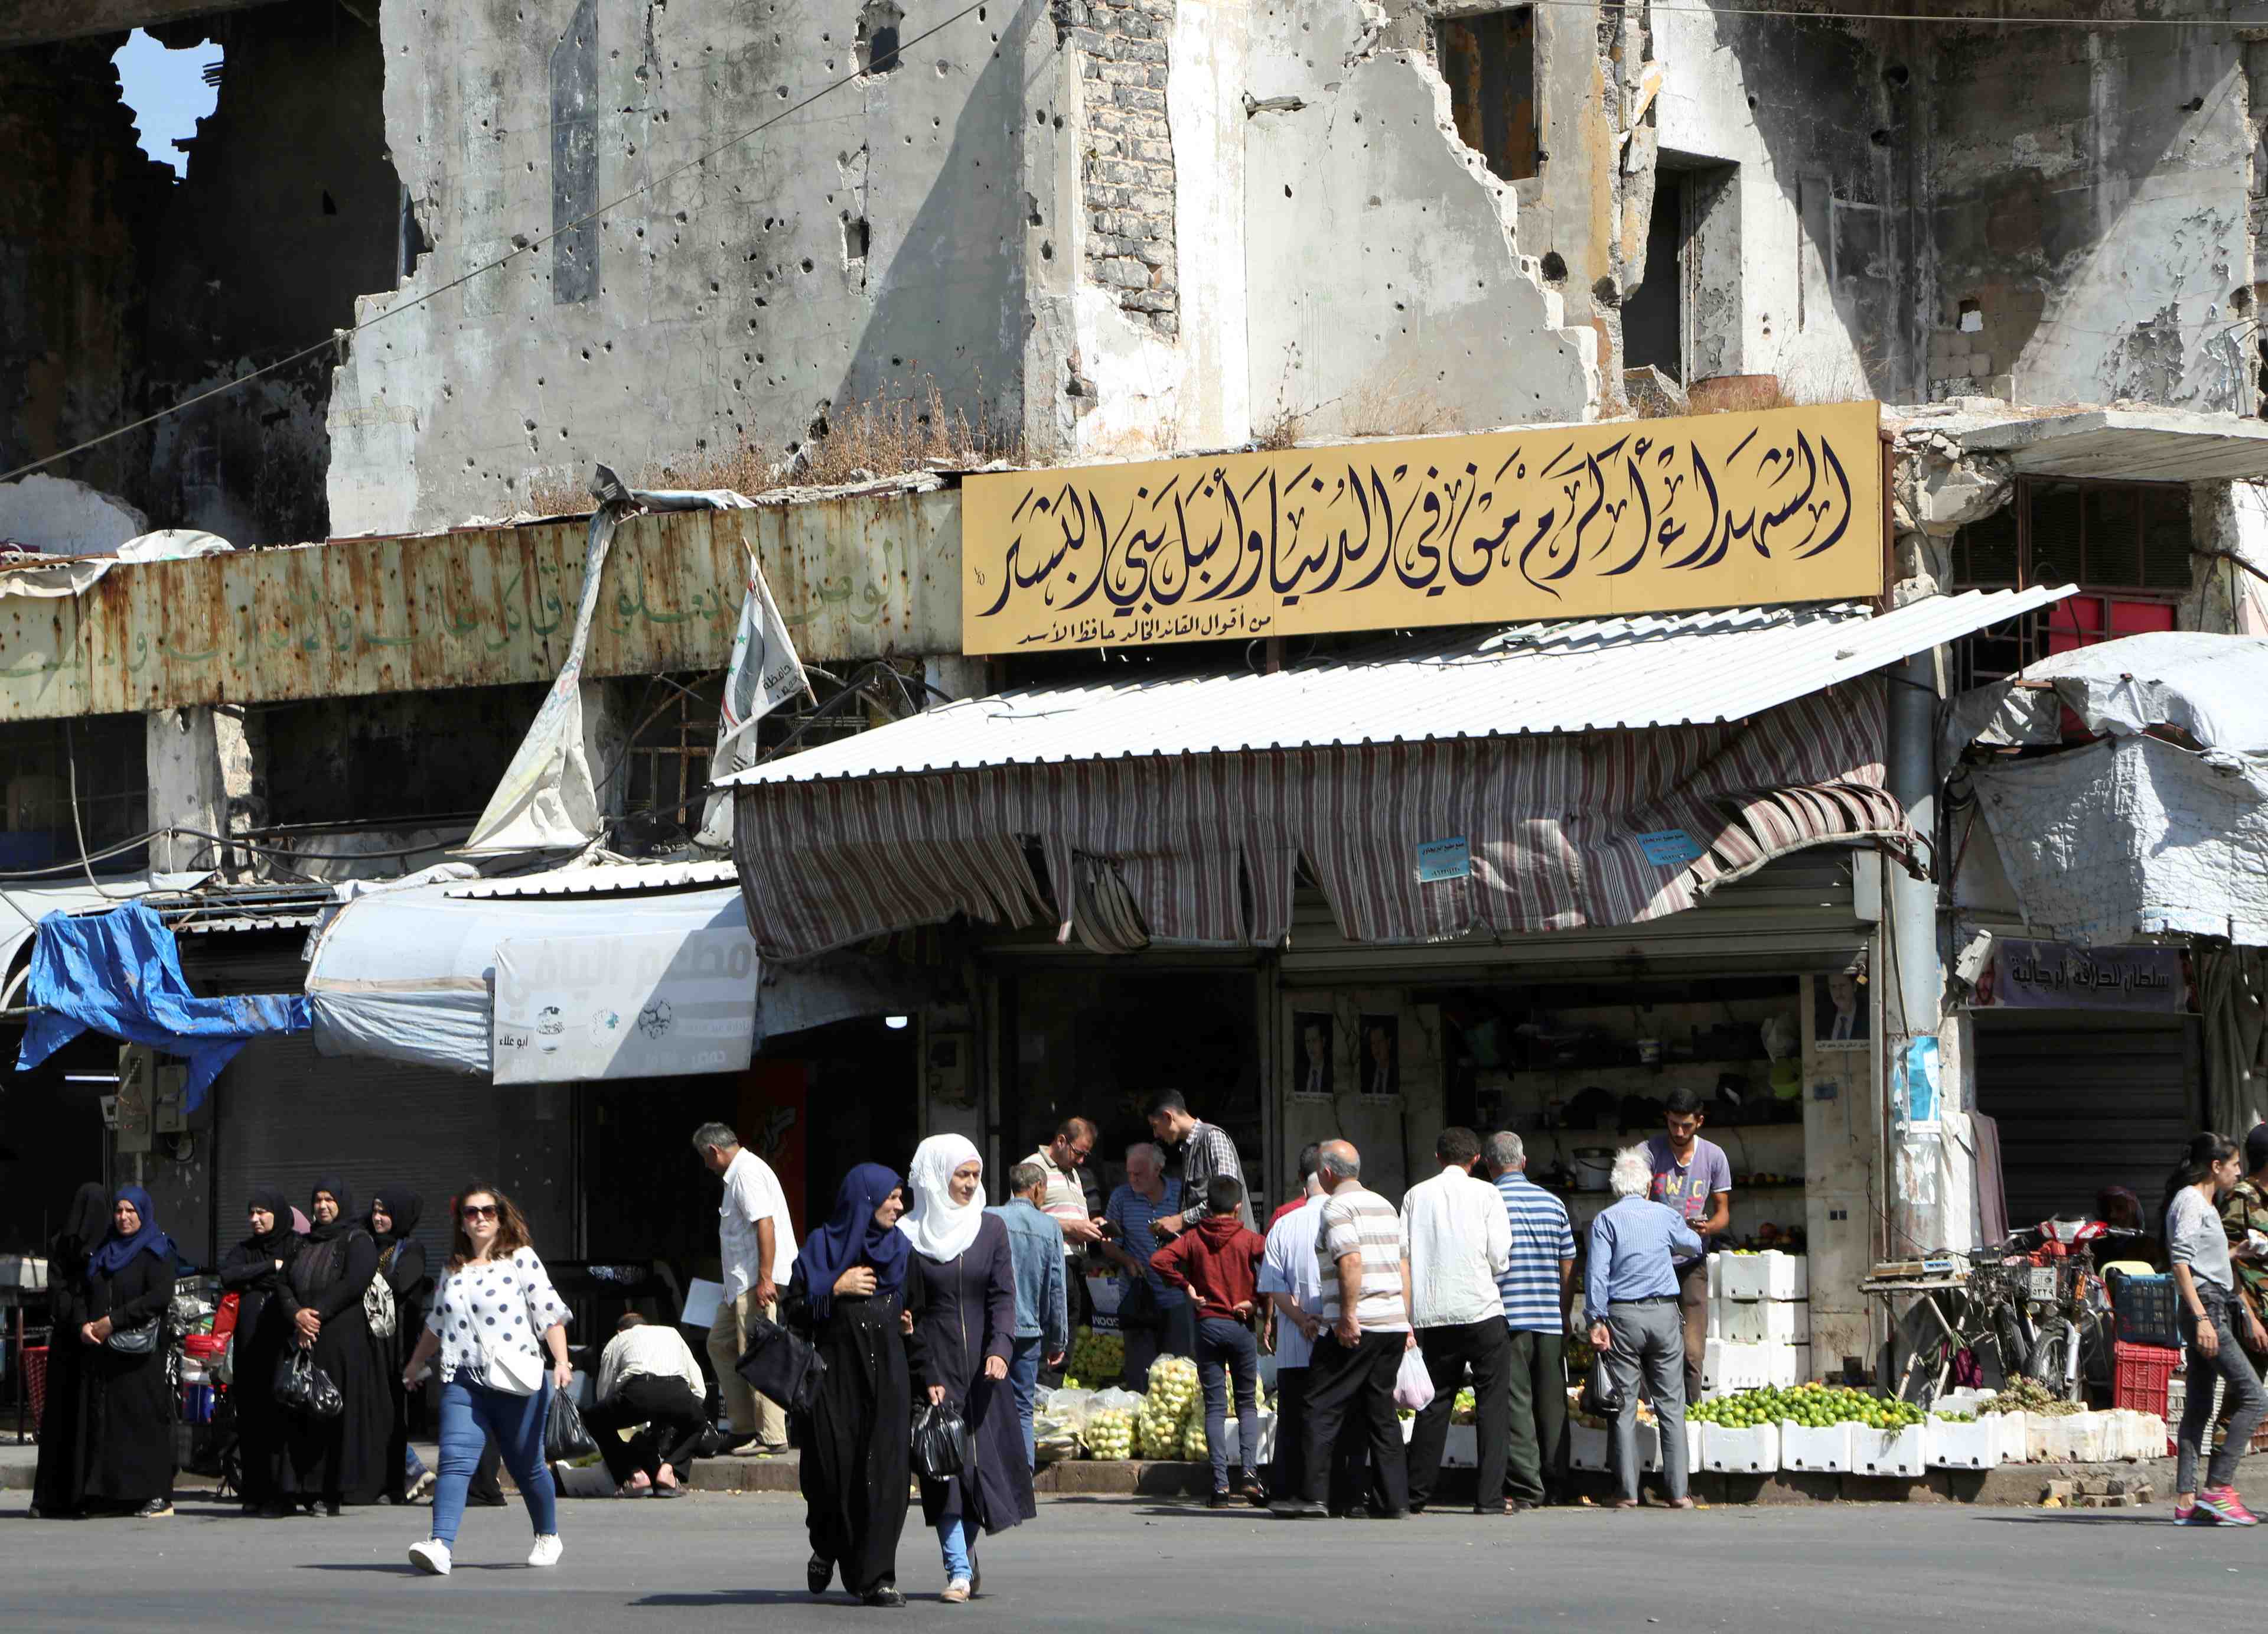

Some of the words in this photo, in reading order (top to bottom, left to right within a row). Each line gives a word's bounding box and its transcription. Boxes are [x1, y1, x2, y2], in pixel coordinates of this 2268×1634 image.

[1015, 621, 1076, 645] الأسد
[1074, 617, 1116, 643] حافظ
[1119, 618, 1159, 642] الخالد
[1158, 614, 1200, 639] القائد
[1201, 608, 1246, 636] أقوال
[1249, 614, 1272, 633] من
[763, 665, 793, 690] حافظة
[2011, 956, 2068, 992] الرجالية
[2124, 963, 2169, 992] سلطان
